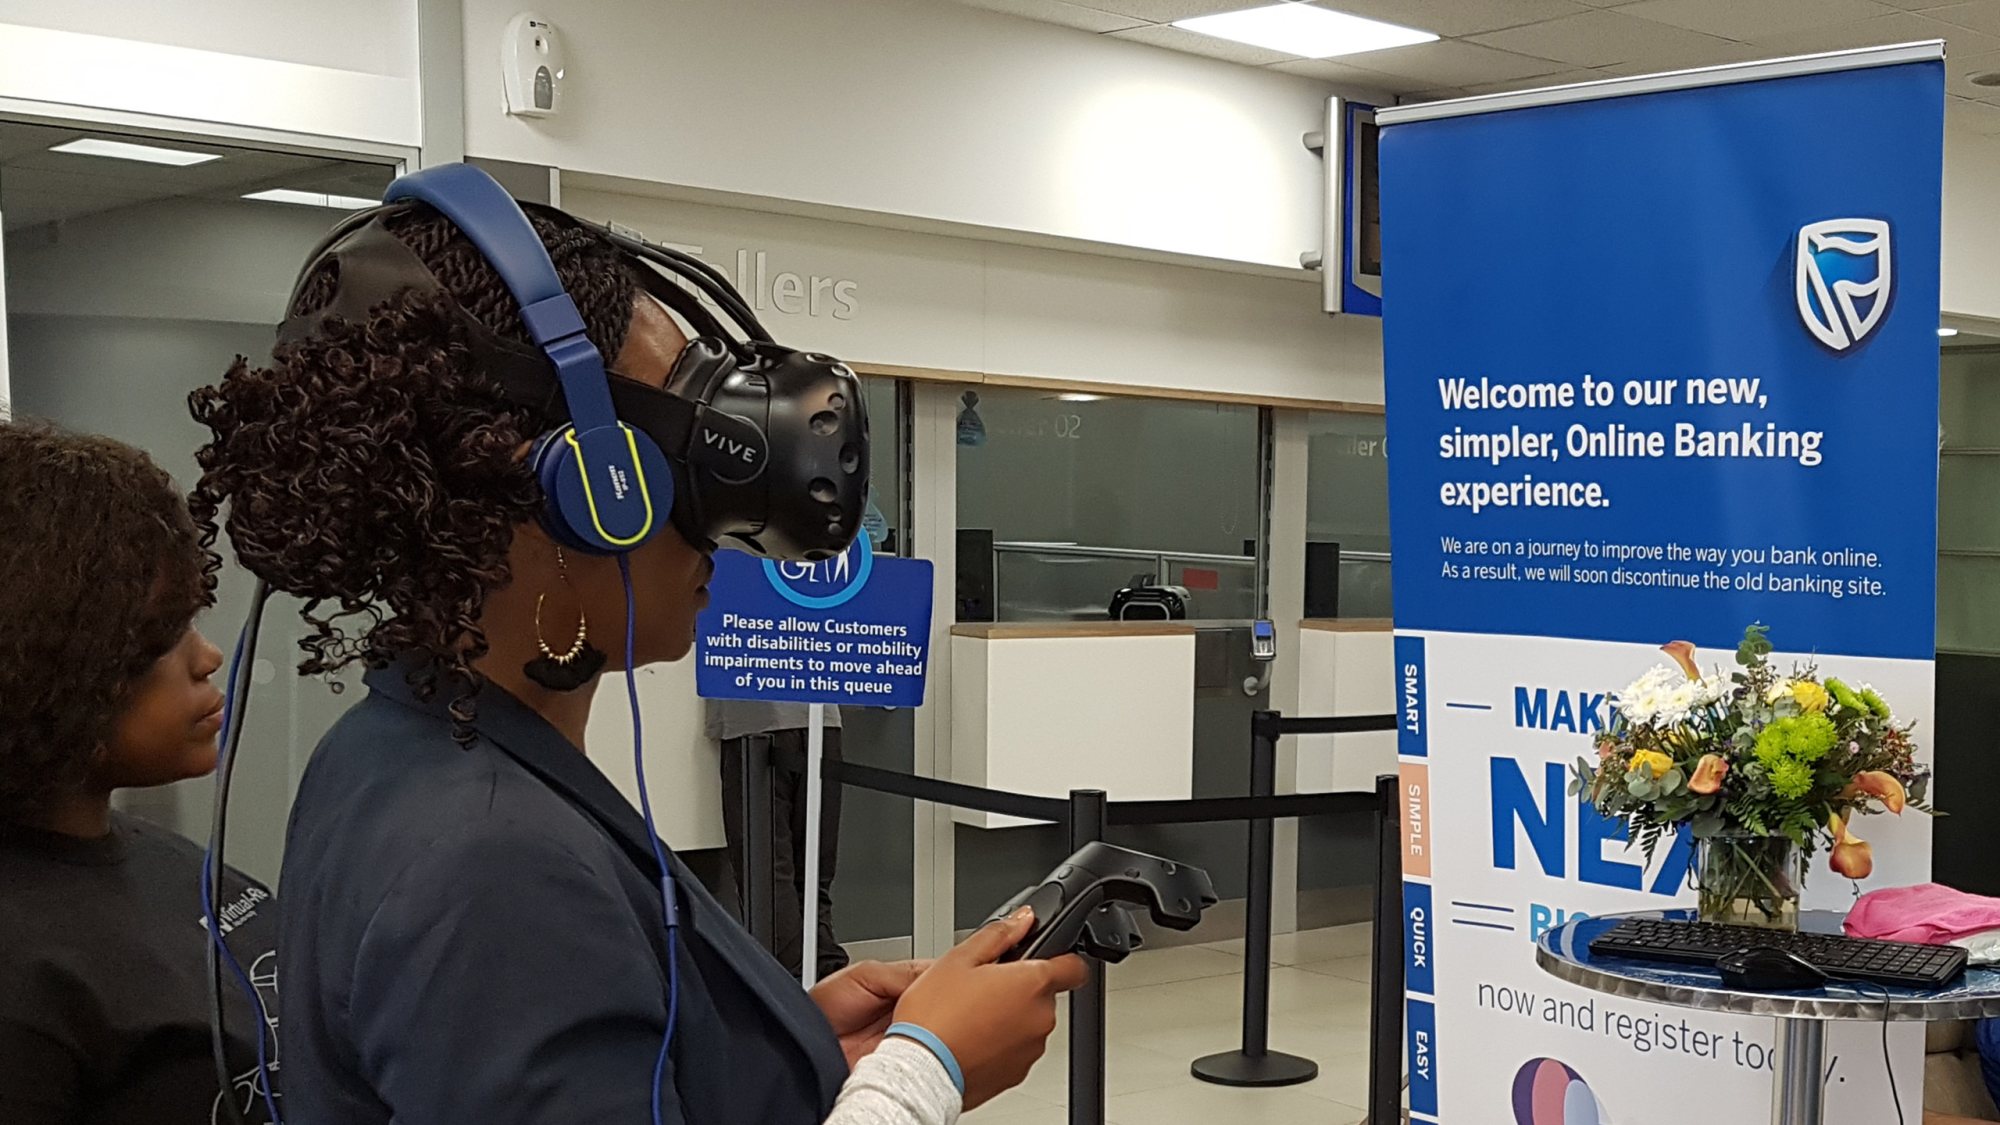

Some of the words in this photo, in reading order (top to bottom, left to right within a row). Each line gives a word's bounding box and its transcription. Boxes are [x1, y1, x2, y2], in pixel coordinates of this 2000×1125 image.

[1438, 376, 1575, 410] Welcome
[1582, 374, 1614, 407] to
[1623, 379, 1677, 406] our
[1686, 377, 1767, 409] new,
[1055, 414, 1081, 438] 02
[1439, 425, 1558, 465] simpler,
[1566, 423, 1665, 457] Online
[1674, 422, 1823, 466] Banking
[704, 429, 756, 463] VIVE
[1440, 474, 1610, 514] experience.
[1440, 536, 1461, 554] We
[1465, 540, 1488, 555] are
[1491, 541, 1512, 555] on
[1515, 542, 1524, 555] a
[1528, 538, 1581, 561] journey
[1584, 540, 1598, 557] to
[1602, 540, 1663, 562] improve
[1667, 542, 1691, 561] the
[1695, 548, 1727, 567] way
[1730, 549, 1765, 567] you
[1771, 545, 1817, 565] bank
[1822, 548, 1882, 568] online.
[1441, 561, 1458, 578] As
[1462, 565, 1470, 578] a
[1525, 566, 1545, 581] we
[1549, 564, 1571, 582] will
[1573, 568, 1608, 583] soon
[1611, 566, 1700, 588] discontinue
[1703, 571, 1730, 589] the
[1734, 572, 1763, 591] old
[1769, 573, 1843, 598] banking
[1848, 576, 1886, 596] site.
[723, 613, 774, 630] Please
[778, 617, 820, 633] allow
[824, 619, 907, 637] Customers
[705, 652, 803, 670] impairments
[808, 657, 825, 671] to
[830, 661, 872, 674] move
[876, 661, 922, 675] ahead
[706, 633, 742, 648] with
[747, 635, 831, 653] disabilities
[836, 642, 853, 654] or
[858, 641, 922, 660] mobility
[735, 673, 753, 687] of
[756, 677, 786, 691] you
[790, 676, 805, 689] in
[809, 677, 840, 691] this
[844, 681, 893, 695] queue
[1404, 663, 1419, 735] SMART
[1408, 784, 1422, 856] SIMPLE
[1410, 907, 1426, 968] QUICK
[1478, 982, 1535, 1017] now
[1543, 998, 1594, 1031] and
[1604, 1012, 1724, 1060] register
[1415, 1030, 1430, 1081] EASY
